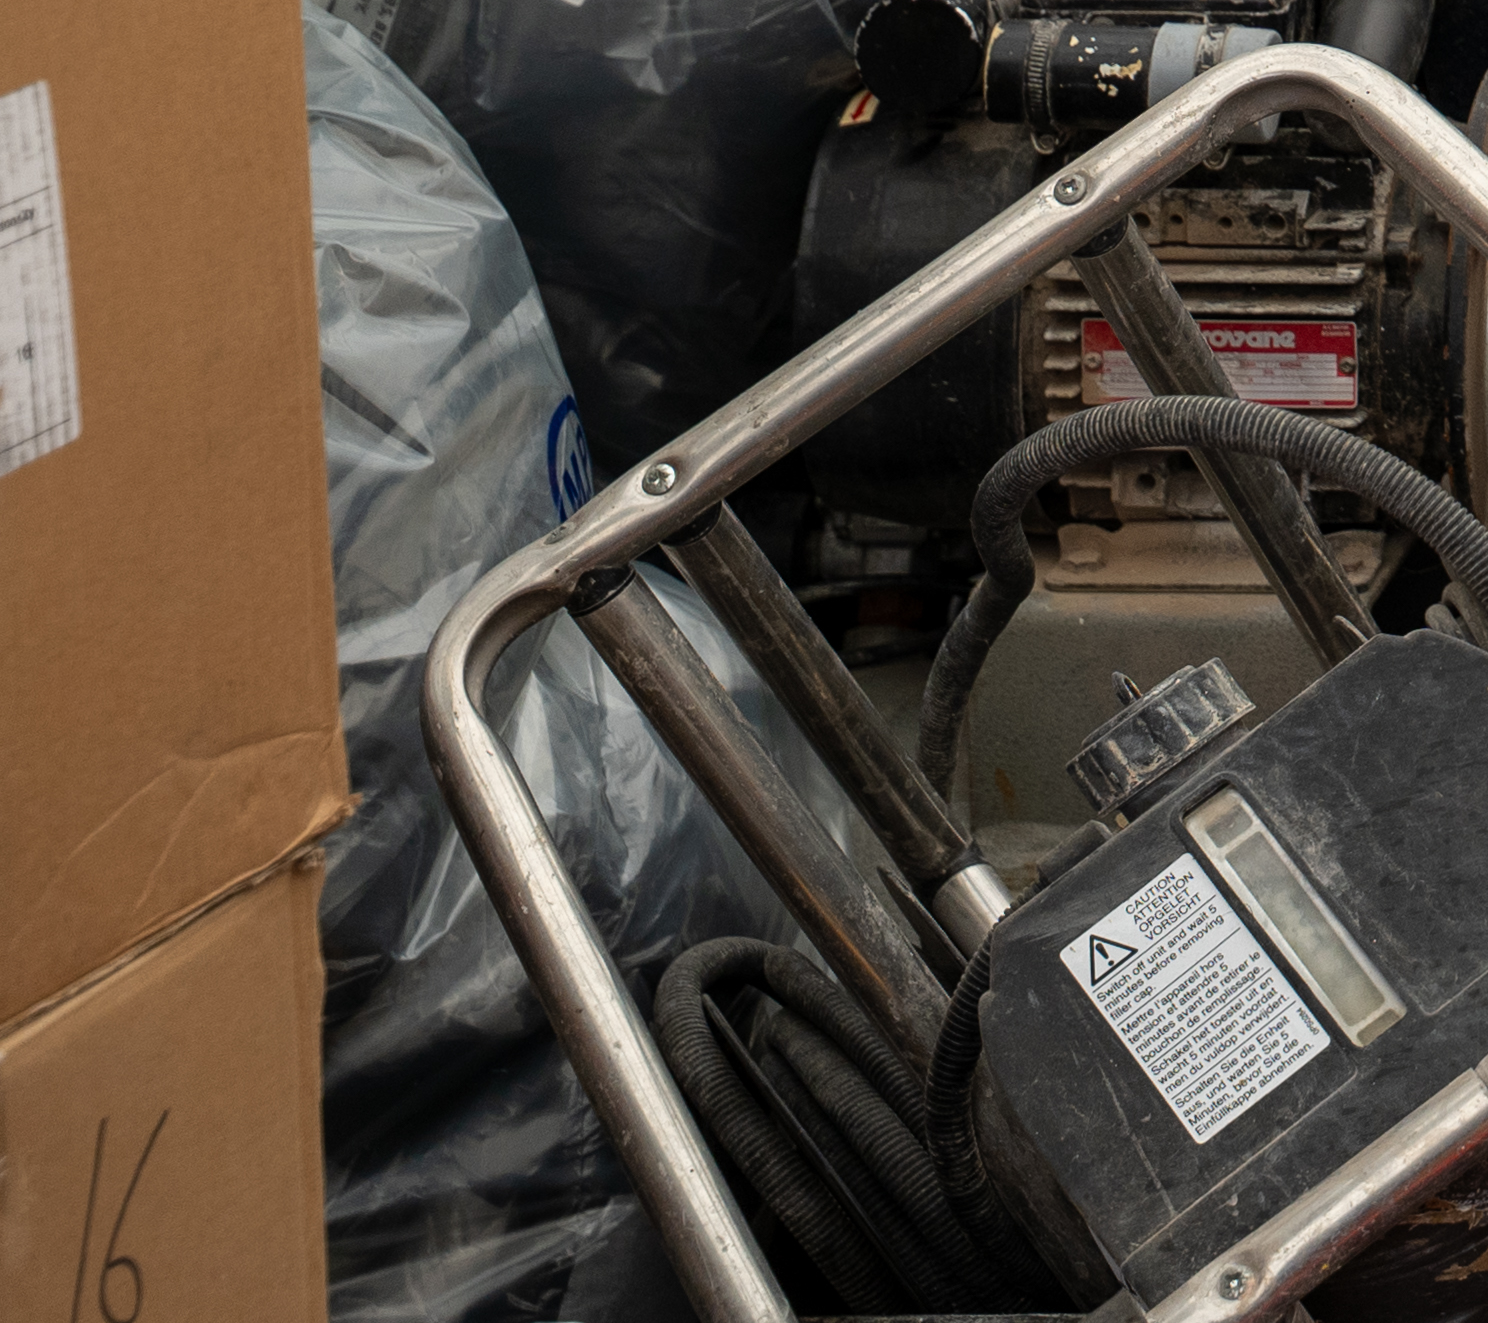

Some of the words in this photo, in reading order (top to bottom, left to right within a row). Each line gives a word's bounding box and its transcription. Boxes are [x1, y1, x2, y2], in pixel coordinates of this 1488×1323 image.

[1202, 327, 1297, 350] rovane
[1123, 871, 1177, 916] CAUTION
[1130, 871, 1196, 925] ATTENTION
[1136, 886, 1193, 934] OPGELET
[1143, 891, 1204, 942] VORSICHT
[1095, 971, 1132, 1003] Switch
[1129, 959, 1148, 976] off
[1144, 944, 1167, 965] unit
[1164, 927, 1188, 949] and
[1185, 910, 1210, 932] wait
[1206, 903, 1218, 915] 5
[1102, 975, 1145, 1012] minutes
[1142, 949, 1178, 981] before
[1175, 912, 1226, 956] removing
[1119, 1005, 1156, 1036] Mettre
[1152, 969, 1203, 1011] l'appareil
[1198, 950, 1226, 974] hors
[1108, 999, 1134, 1022] filler
[1131, 981, 1158, 1006] cap.
[1126, 1011, 1167, 1046] tension
[1164, 1001, 1179, 1016] et
[1175, 968, 1221, 1006] attendre
[1217, 961, 1230, 973] 5
[1132, 1017, 1177, 1054] minutes
[1173, 995, 1206, 1023] avant
[1202, 982, 1220, 1000] de
[1217, 959, 1250, 987] retirer
[1248, 949, 1262, 963] le
[1139, 1024, 1187, 1064] bouchon
[1183, 1012, 1201, 1029] de
[1198, 961, 1267, 1018] remplissage.
[1149, 1039, 1194, 1077] Schakel
[1190, 1025, 1212, 1044] het
[1208, 997, 1246, 1030] toestel
[1242, 986, 1260, 1003] uit
[1257, 975, 1275, 991] en
[1155, 1056, 1190, 1086] wacht
[1187, 1049, 1199, 1061] 5
[1195, 1016, 1241, 1054] minuten
[1237, 986, 1279, 1022] voordat
[1162, 1071, 1189, 1095] men
[1186, 1059, 1205, 1076] du
[1201, 1031, 1241, 1066] vuldop
[1235, 991, 1292, 1038] verwijdert.
[1173, 1069, 1221, 1109] Schalten
[1218, 1054, 1240, 1074] Sie
[1236, 1040, 1257, 1059] die
[1180, 1096, 1206, 1119] aus,
[1203, 1078, 1227, 1100] und
[1224, 1051, 1263, 1083] warten
[1260, 1036, 1281, 1056] Sie
[1278, 1029, 1290, 1041] 5
[1186, 1088, 1234, 1128] Minuten,
[1231, 1064, 1264, 1092] bevor
[1261, 1049, 1282, 1069] Sie
[1279, 1035, 1300, 1054] die
[1193, 1083, 1260, 1137] Einfüllkappe
[1255, 1039, 1315, 1088] abnehmen.
[72, 1109, 170, 1323] 16
